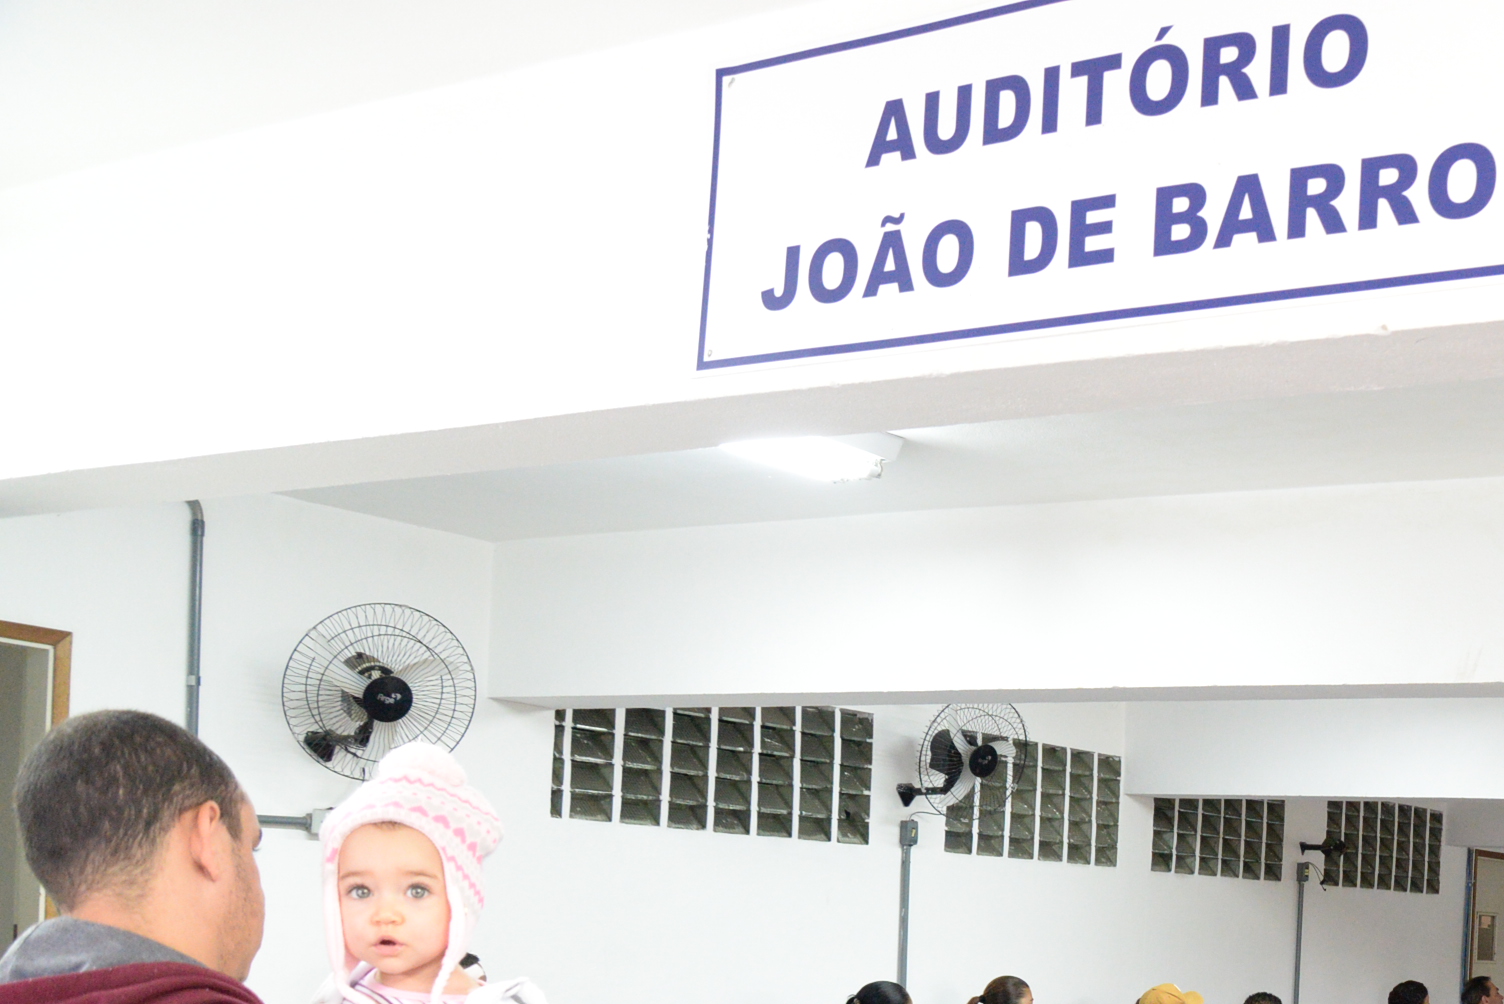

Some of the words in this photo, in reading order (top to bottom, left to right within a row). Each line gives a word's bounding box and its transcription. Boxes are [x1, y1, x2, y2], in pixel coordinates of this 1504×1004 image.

[865, 13, 1369, 168] AUDITÓRIO
[761, 213, 975, 311] JOÃO
[1009, 195, 1117, 278] DE
[1154, 143, 1497, 257] BARRO
